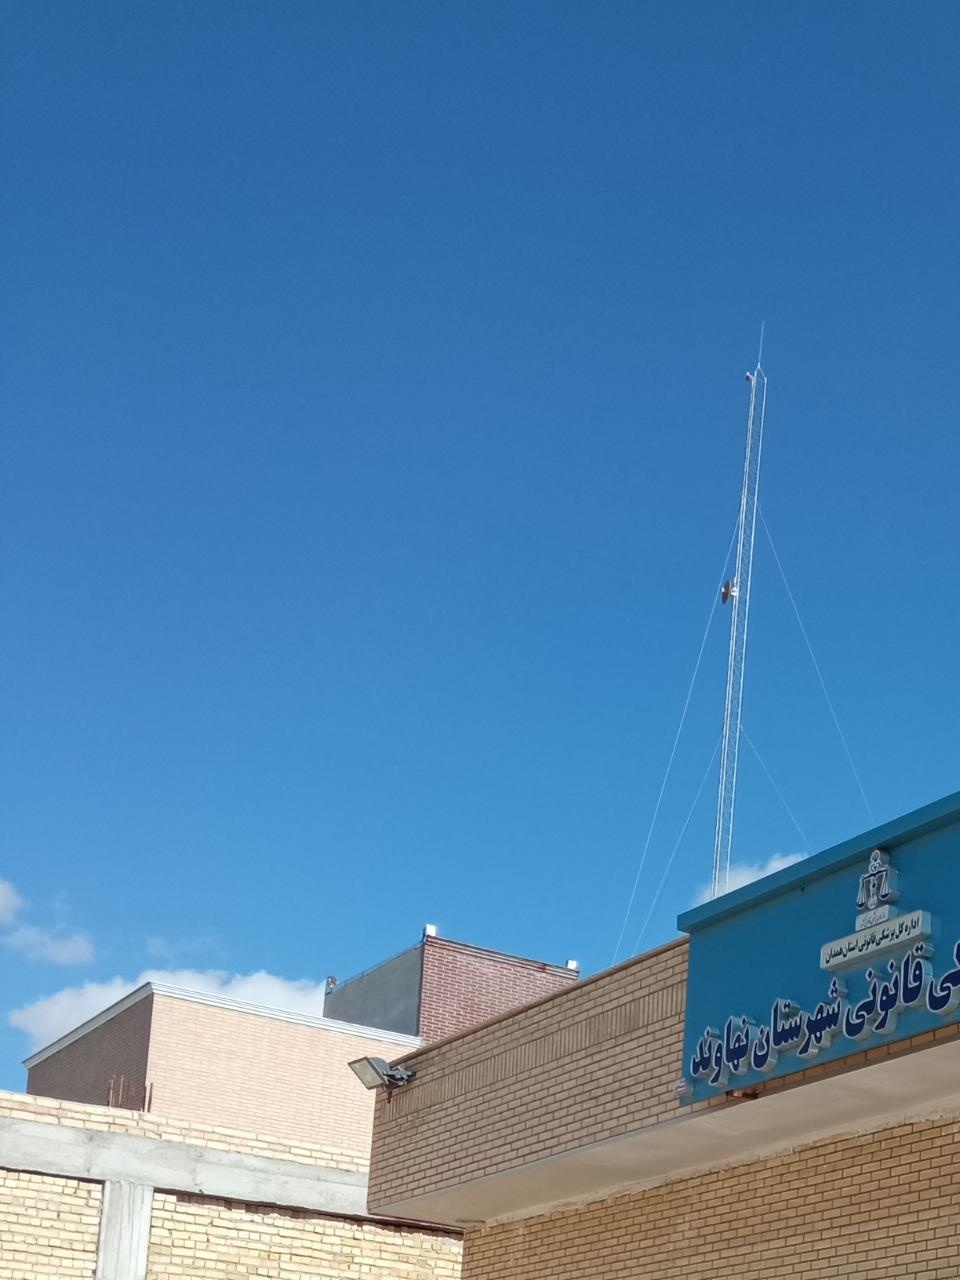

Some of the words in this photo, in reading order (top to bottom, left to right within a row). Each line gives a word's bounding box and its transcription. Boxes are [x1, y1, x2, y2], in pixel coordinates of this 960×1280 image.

[895, 922, 905, 939] کل
[905, 917, 920, 935] اداره
[858, 935, 877, 952] قانونی
[876, 928, 896, 945] پزشکی
[825, 945, 843, 964] همدان
[843, 939, 859, 957] استان
[843, 943, 924, 1038] قانونی
[751, 977, 842, 1072] شهرستان
[690, 1014, 751, 1086] نهاوند
